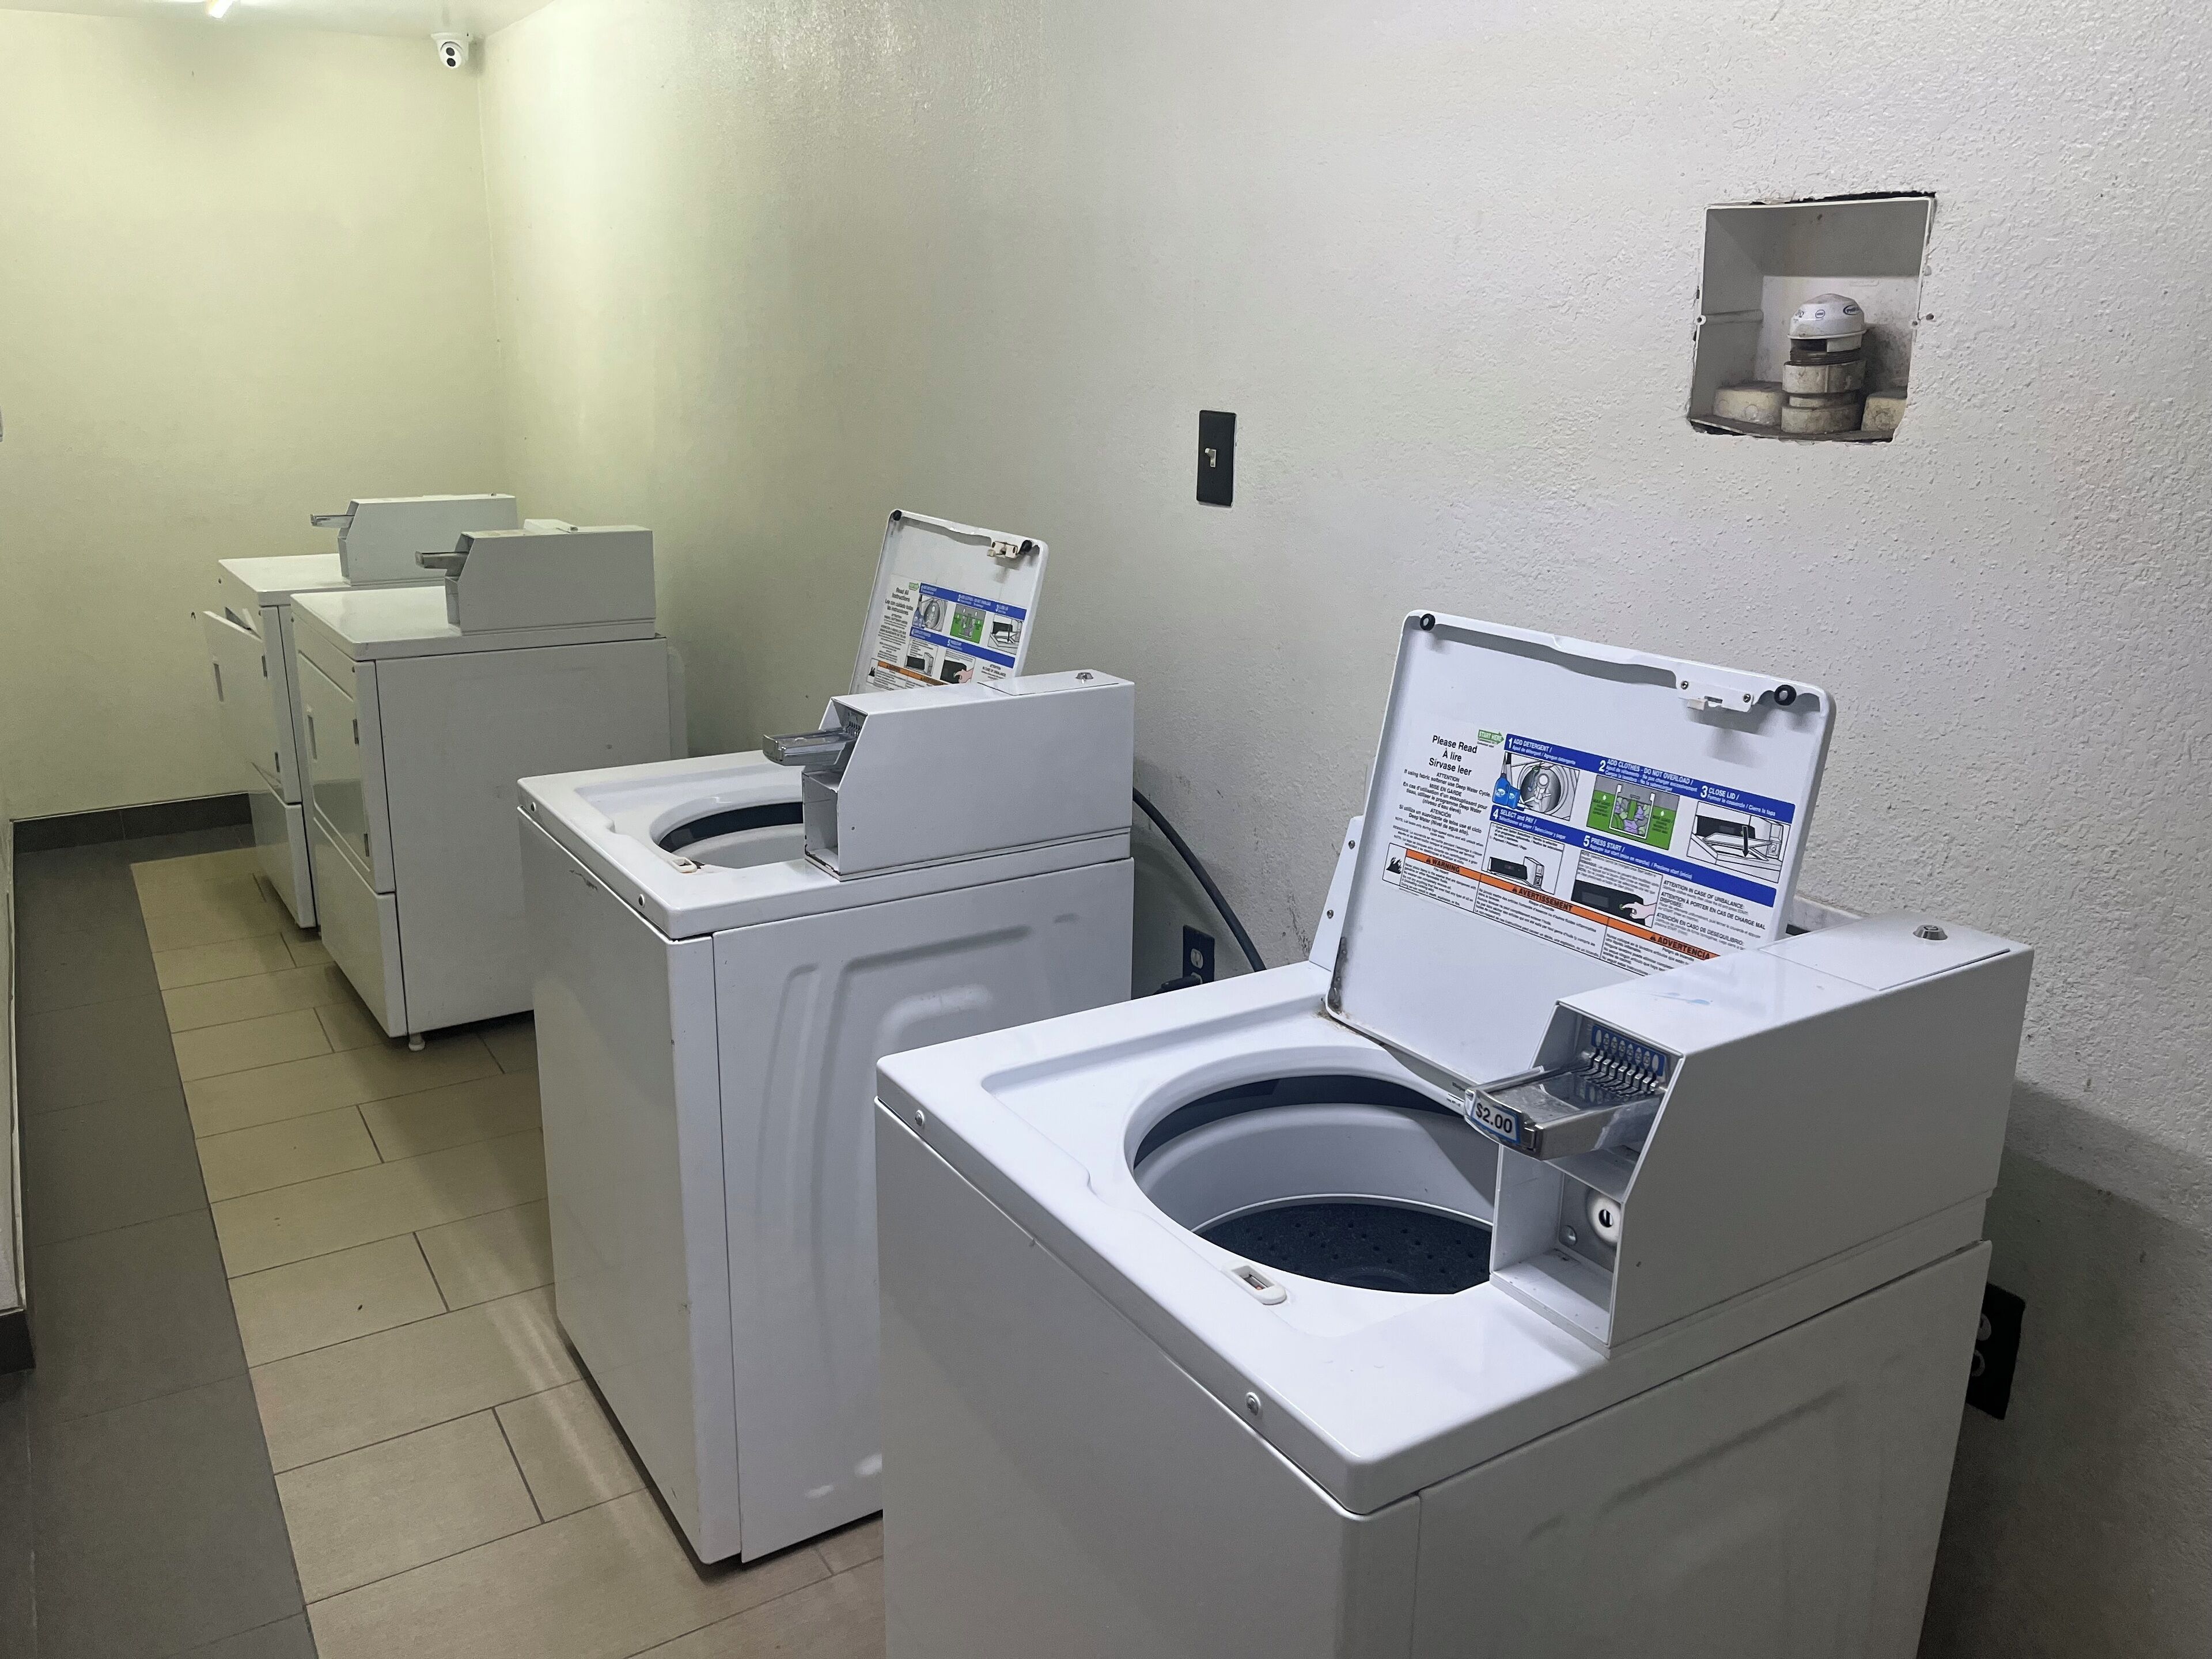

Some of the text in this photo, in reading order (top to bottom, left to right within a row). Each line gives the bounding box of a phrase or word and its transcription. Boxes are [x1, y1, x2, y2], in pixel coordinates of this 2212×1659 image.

[1432, 734, 1457, 748] Please
[1458, 741, 1477, 754] Read
[1507, 737, 1513, 748] 1
[1523, 740, 1550, 752] DETERGENT
[1442, 747, 1462, 762] À lire
[1429, 757, 1472, 777] Sírvase leer
[1599, 759, 1606, 772] 2
[1436, 772, 1460, 782] ATTENTION
[1618, 762, 1640, 772] CLOTHES
[1662, 772, 1690, 784] OVERLOAD
[1446, 788, 1462, 797] GARDE
[1699, 785, 1709, 798] 3
[1708, 787, 1726, 797] CLOSE
[1726, 791, 1736, 800] LID
[1430, 807, 1451, 819] ATENCIÓN
[1492, 808, 1499, 819] 4
[1499, 809, 1517, 819] SELECT
[1582, 835, 1590, 847] 5
[1590, 837, 1606, 847] PRESS
[1606, 842, 1622, 851] START
[1431, 858, 1460, 873] WARNING
[1663, 880, 1688, 892] ATTENTION
[1694, 889, 1706, 897] CASE
[1518, 887, 1572, 912] AVERTISSEMENT
[1661, 891, 1685, 903] ATTENTION
[1690, 900, 1709, 911] PORTER
[1734, 915, 1755, 926] CHARGE
[1656, 911, 1679, 924] ATENCIÓN
[1686, 922, 1699, 931] CASO
[1657, 935, 1710, 960] ADVERTENCIA
[1476, 1102, 1513, 1134] $2.00
